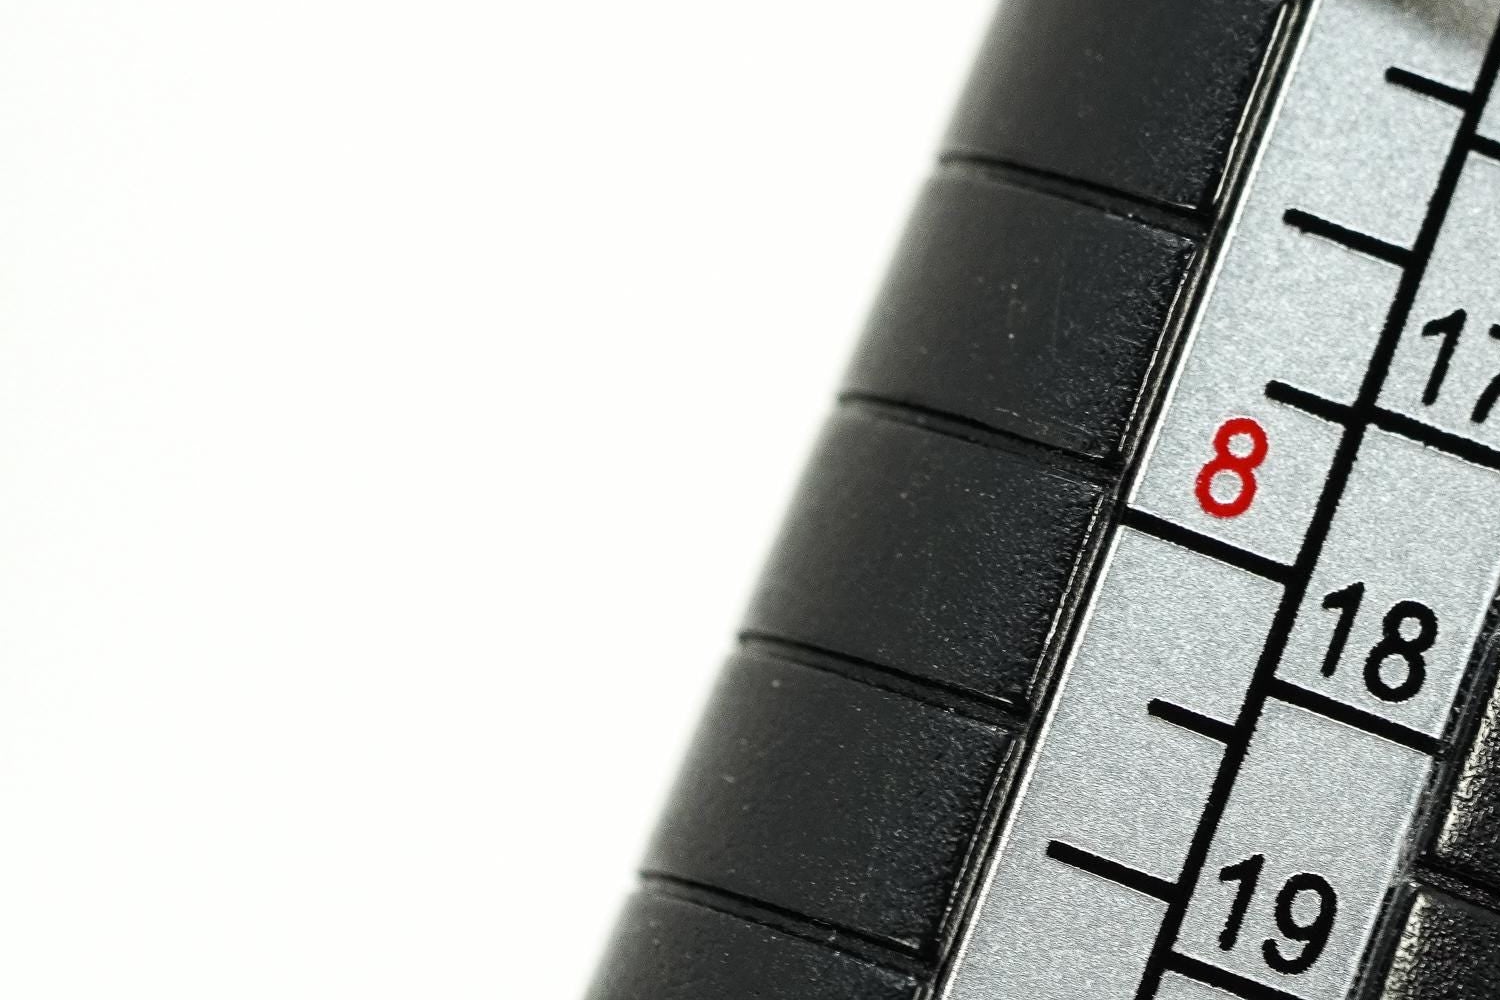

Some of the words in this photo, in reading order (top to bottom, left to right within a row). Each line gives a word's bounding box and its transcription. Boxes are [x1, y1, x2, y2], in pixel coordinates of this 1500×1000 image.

[1192, 416, 1270, 521] 8
[1318, 580, 1440, 705] 18
[1215, 852, 1340, 977] 19
